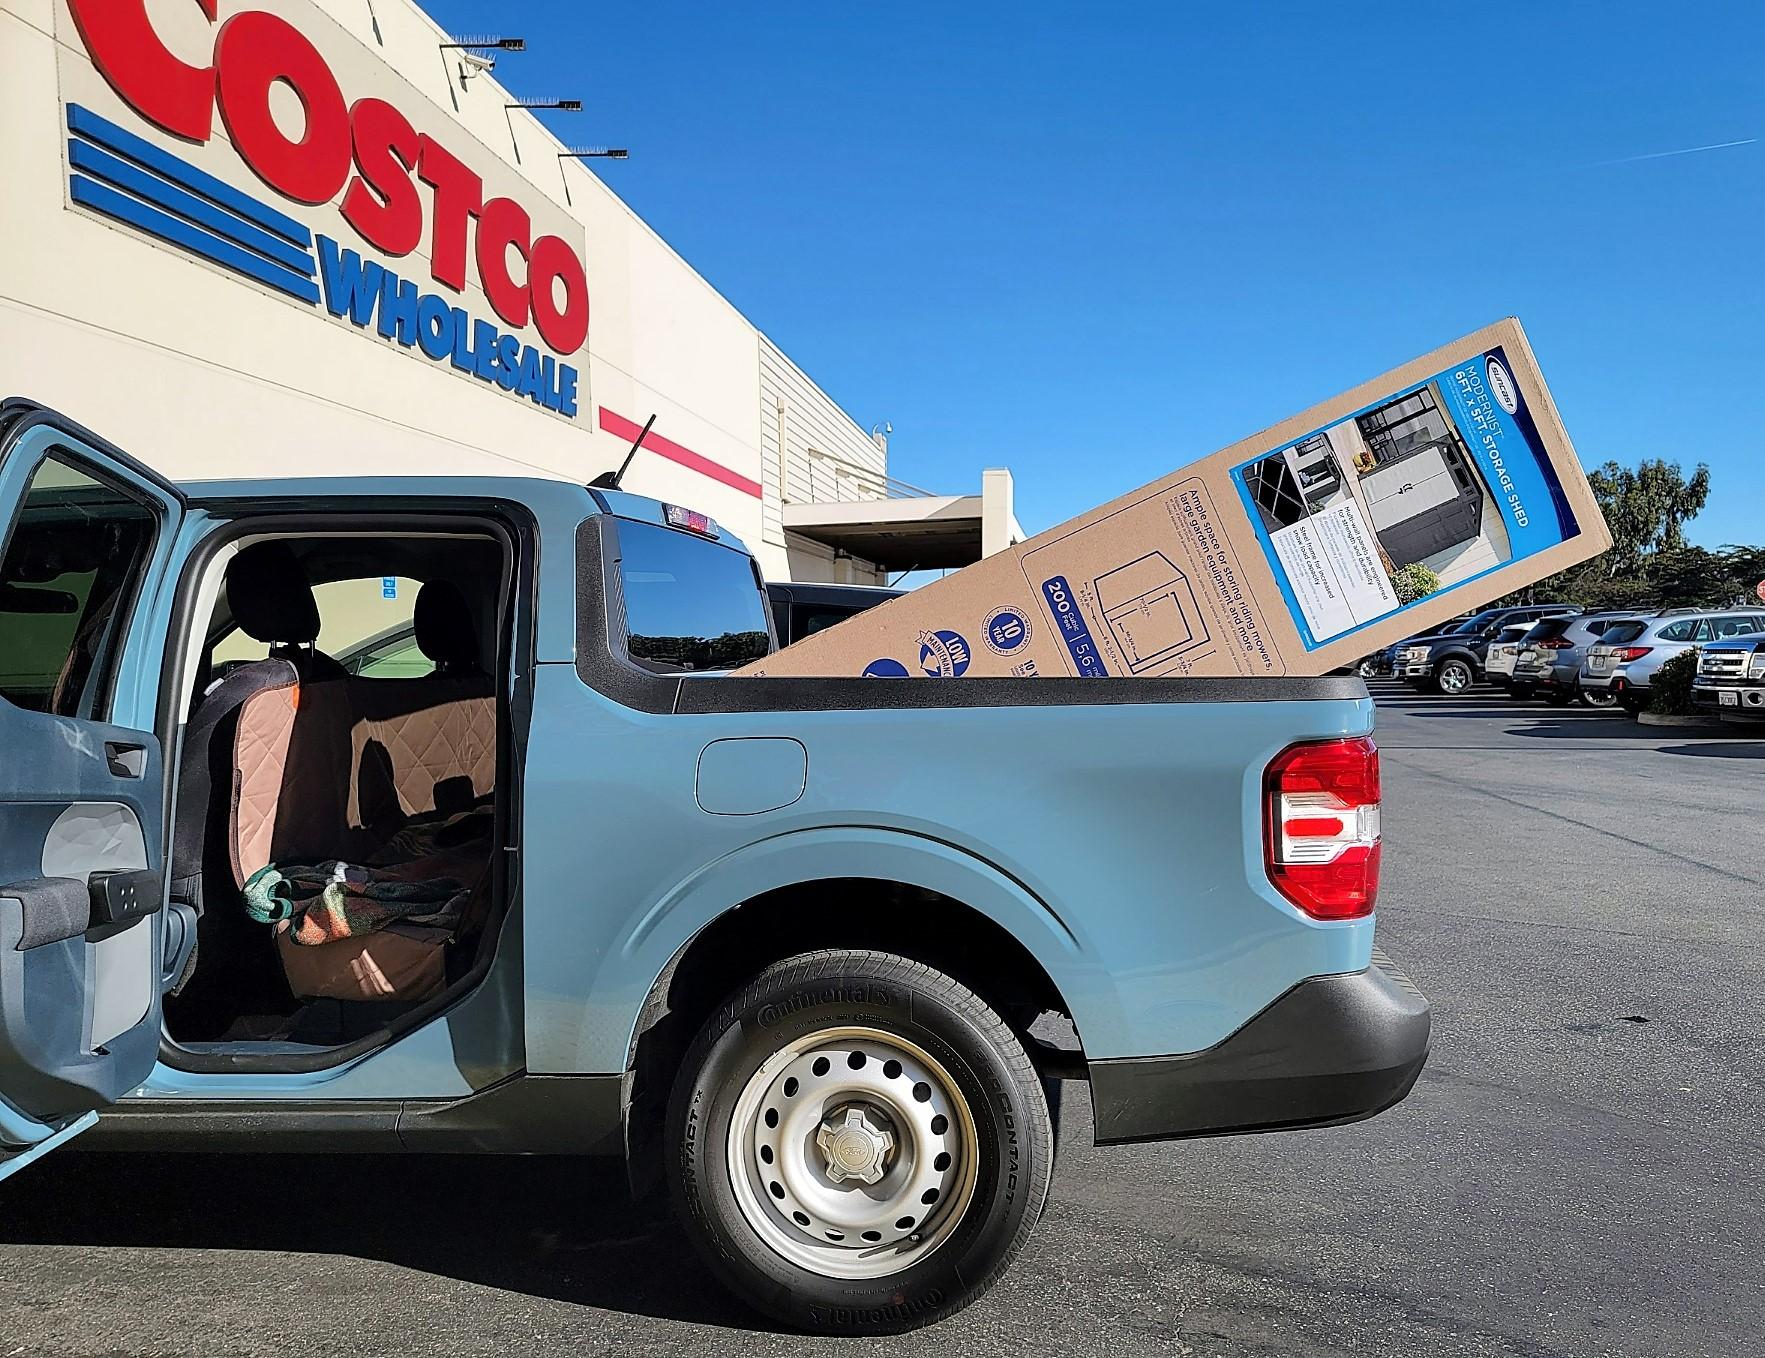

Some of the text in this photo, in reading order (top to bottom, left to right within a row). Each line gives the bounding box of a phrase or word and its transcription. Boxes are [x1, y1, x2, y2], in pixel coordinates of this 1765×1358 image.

[72, 0, 589, 355] COSTCO
[315, 234, 578, 418] WHOLESALE
[1489, 364, 1514, 409] suncast
[1453, 369, 1473, 397] 6FT.
[1469, 407, 1489, 434] 5FT.
[1481, 434, 1515, 493] STORAGE
[1506, 492, 1530, 529] SHED
[1336, 507, 1346, 519] for
[1342, 505, 1361, 536] Multi-wall
[1291, 528, 1303, 545] snow
[1297, 525, 1310, 542] Steel
[1339, 517, 1357, 545] strength
[1298, 544, 1310, 560] load
[1304, 541, 1318, 560] frame
[1351, 543, 1362, 557] and
[1354, 534, 1369, 556] panels
[1177, 491, 1196, 519] large
[1188, 517, 1212, 554] garden
[1204, 552, 1235, 606] equipment
[1228, 604, 1244, 625] and
[1236, 625, 1254, 652] more
[1303, 559, 1321, 586] capacity
[1313, 559, 1323, 570] for
[1356, 556, 1375, 586] durability
[1364, 555, 1373, 567] are
[1187, 487, 1274, 671] Ample space for storing riding mowers,
[1317, 569, 1335, 599] increased
[1368, 565, 1389, 601] engineered
[1047, 580, 1071, 614] 200
[982, 614, 1008, 654] LIMITED WARRANTY
[991, 625, 1005, 644] YEAR
[999, 618, 1022, 640] 10
[1004, 607, 1031, 648] LIMITED WARRANTY
[1060, 613, 1073, 631] Feet
[1066, 611, 1080, 632] Cubic
[925, 636, 951, 675] MAINTENANC
[944, 636, 968, 666] LOW
[1022, 658, 1036, 671] 10
[1073, 641, 1095, 668] 5,6
